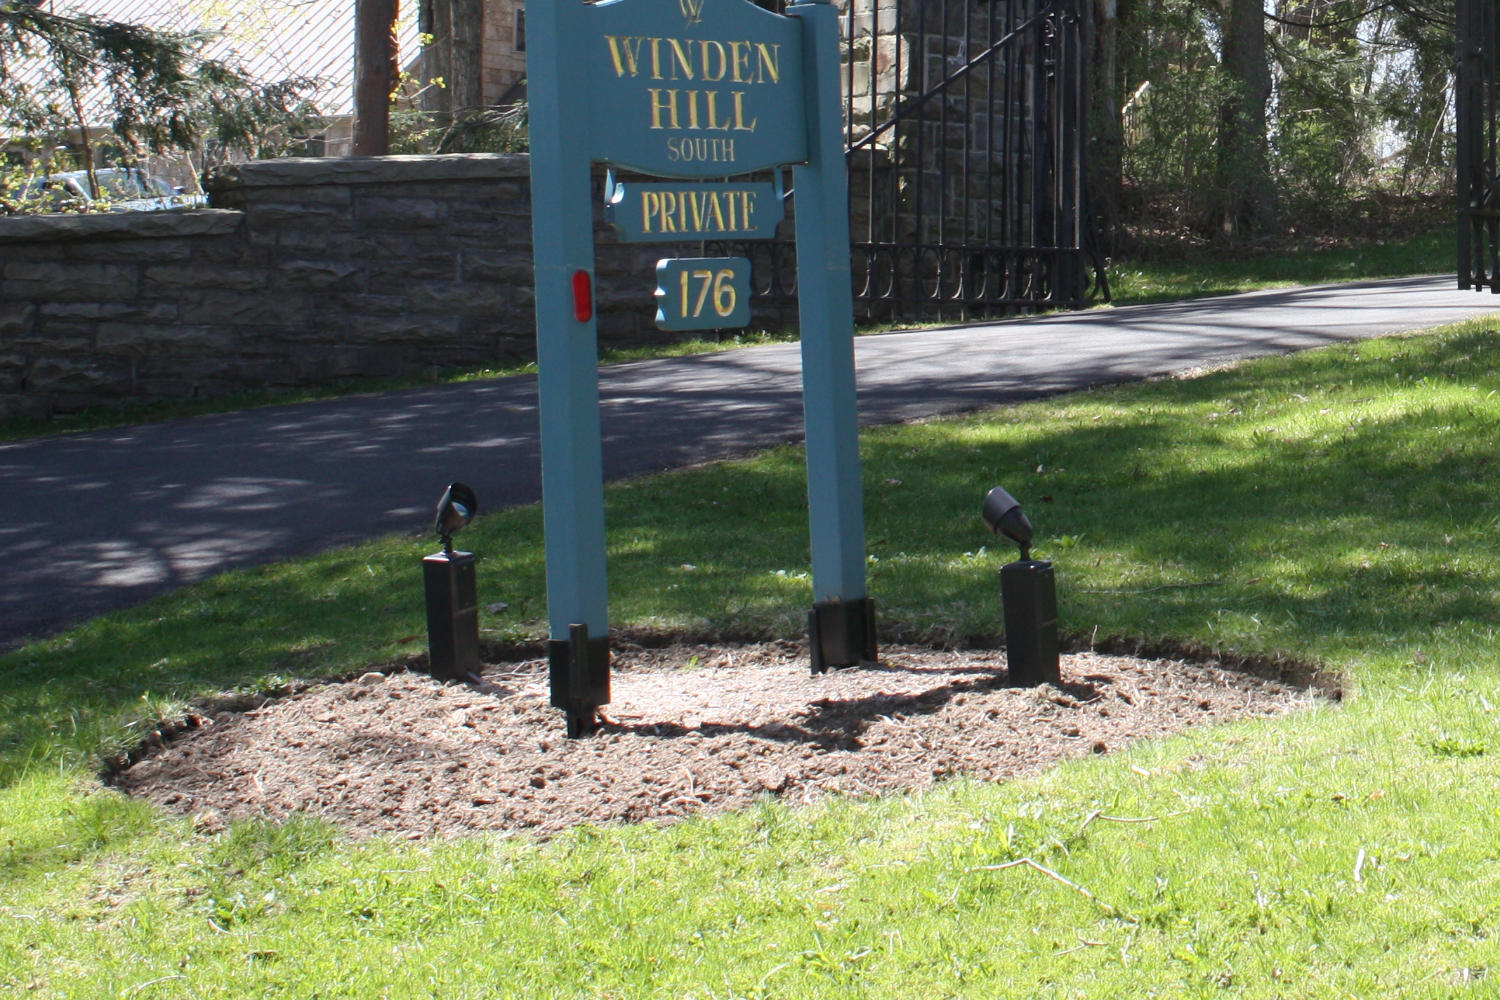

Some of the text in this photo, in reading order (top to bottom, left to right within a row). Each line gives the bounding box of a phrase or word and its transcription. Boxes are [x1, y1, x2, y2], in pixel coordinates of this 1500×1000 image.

[605, 35, 781, 84] WINDEN
[648, 88, 757, 132] HILL
[667, 137, 736, 163] SOUTH
[641, 191, 758, 234] PRIVATE
[680, 269, 737, 319] 176
